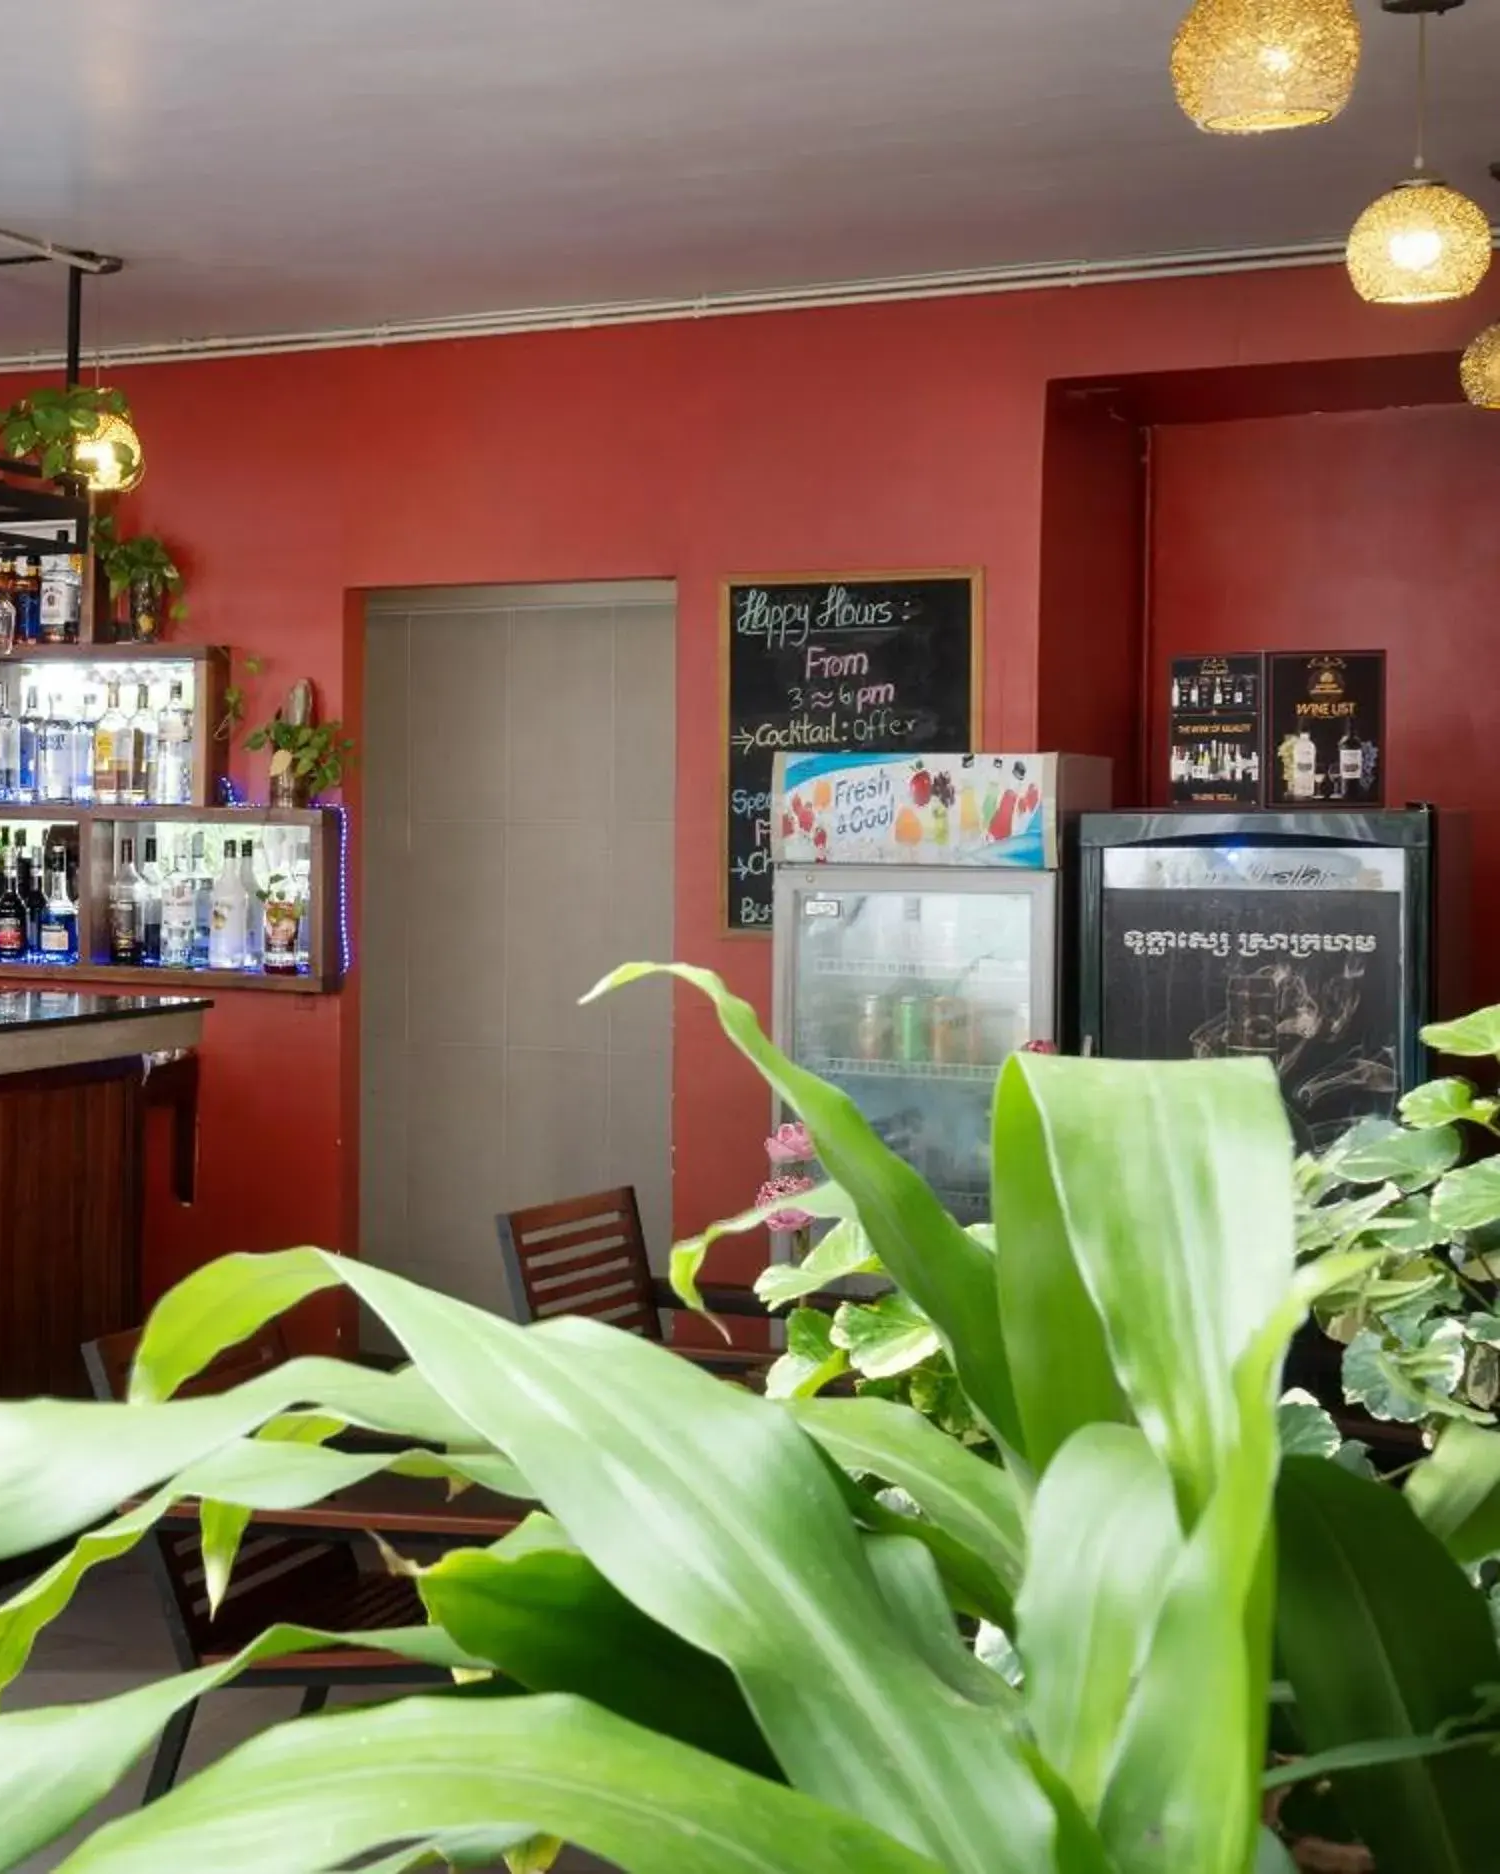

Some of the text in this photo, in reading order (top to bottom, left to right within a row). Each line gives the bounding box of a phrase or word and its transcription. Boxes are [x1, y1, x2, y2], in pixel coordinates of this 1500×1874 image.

[737, 588, 810, 649] Happy
[805, 646, 869, 681] From
[856, 683, 895, 713] pm
[1296, 701, 1356, 715] WINE LIST
[853, 707, 917, 741] Offer
[835, 768, 890, 808] Fresh
[850, 794, 894, 833] Cool
